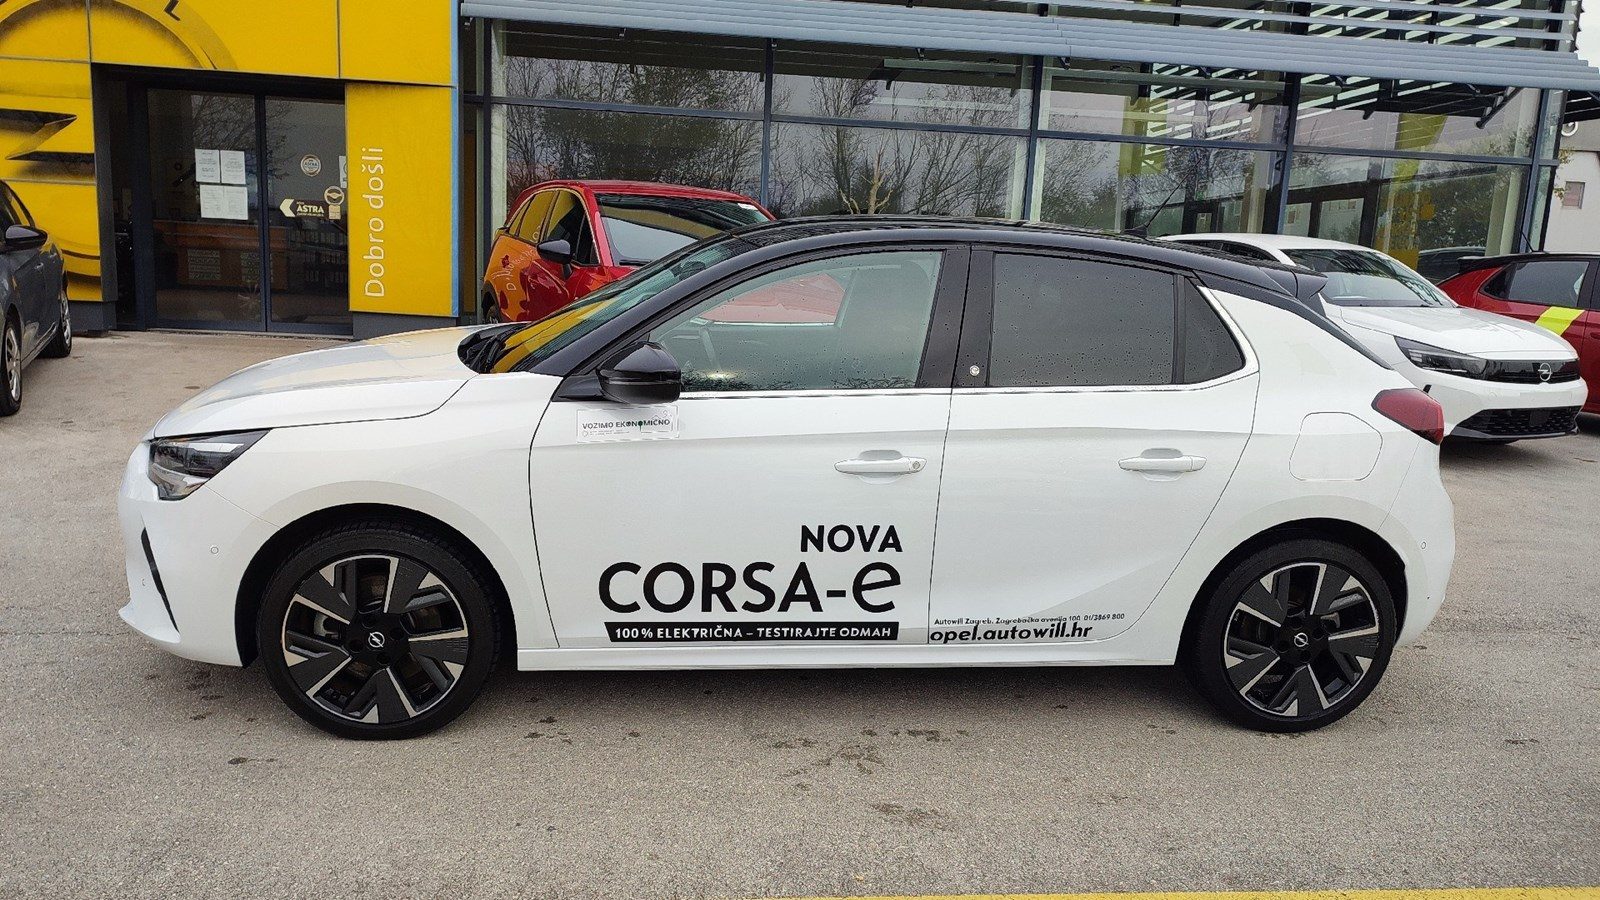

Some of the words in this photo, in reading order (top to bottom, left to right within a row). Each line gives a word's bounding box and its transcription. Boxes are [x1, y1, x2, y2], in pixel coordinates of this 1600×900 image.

[361, 147, 385, 209] došli
[296, 204, 325, 214] ASTRA
[364, 217, 385, 297] Dobro
[582, 421, 614, 430] VOZIMO
[615, 418, 670, 429] EKONOMIČNO
[800, 524, 903, 552] NOVA
[598, 561, 901, 613] CORSA-e
[656, 625, 743, 639] ELEKTRIČNA
[757, 627, 836, 638] TESTIRAJTE
[839, 627, 891, 638] ODMAH
[930, 621, 1093, 644] opel.autowill.hr
